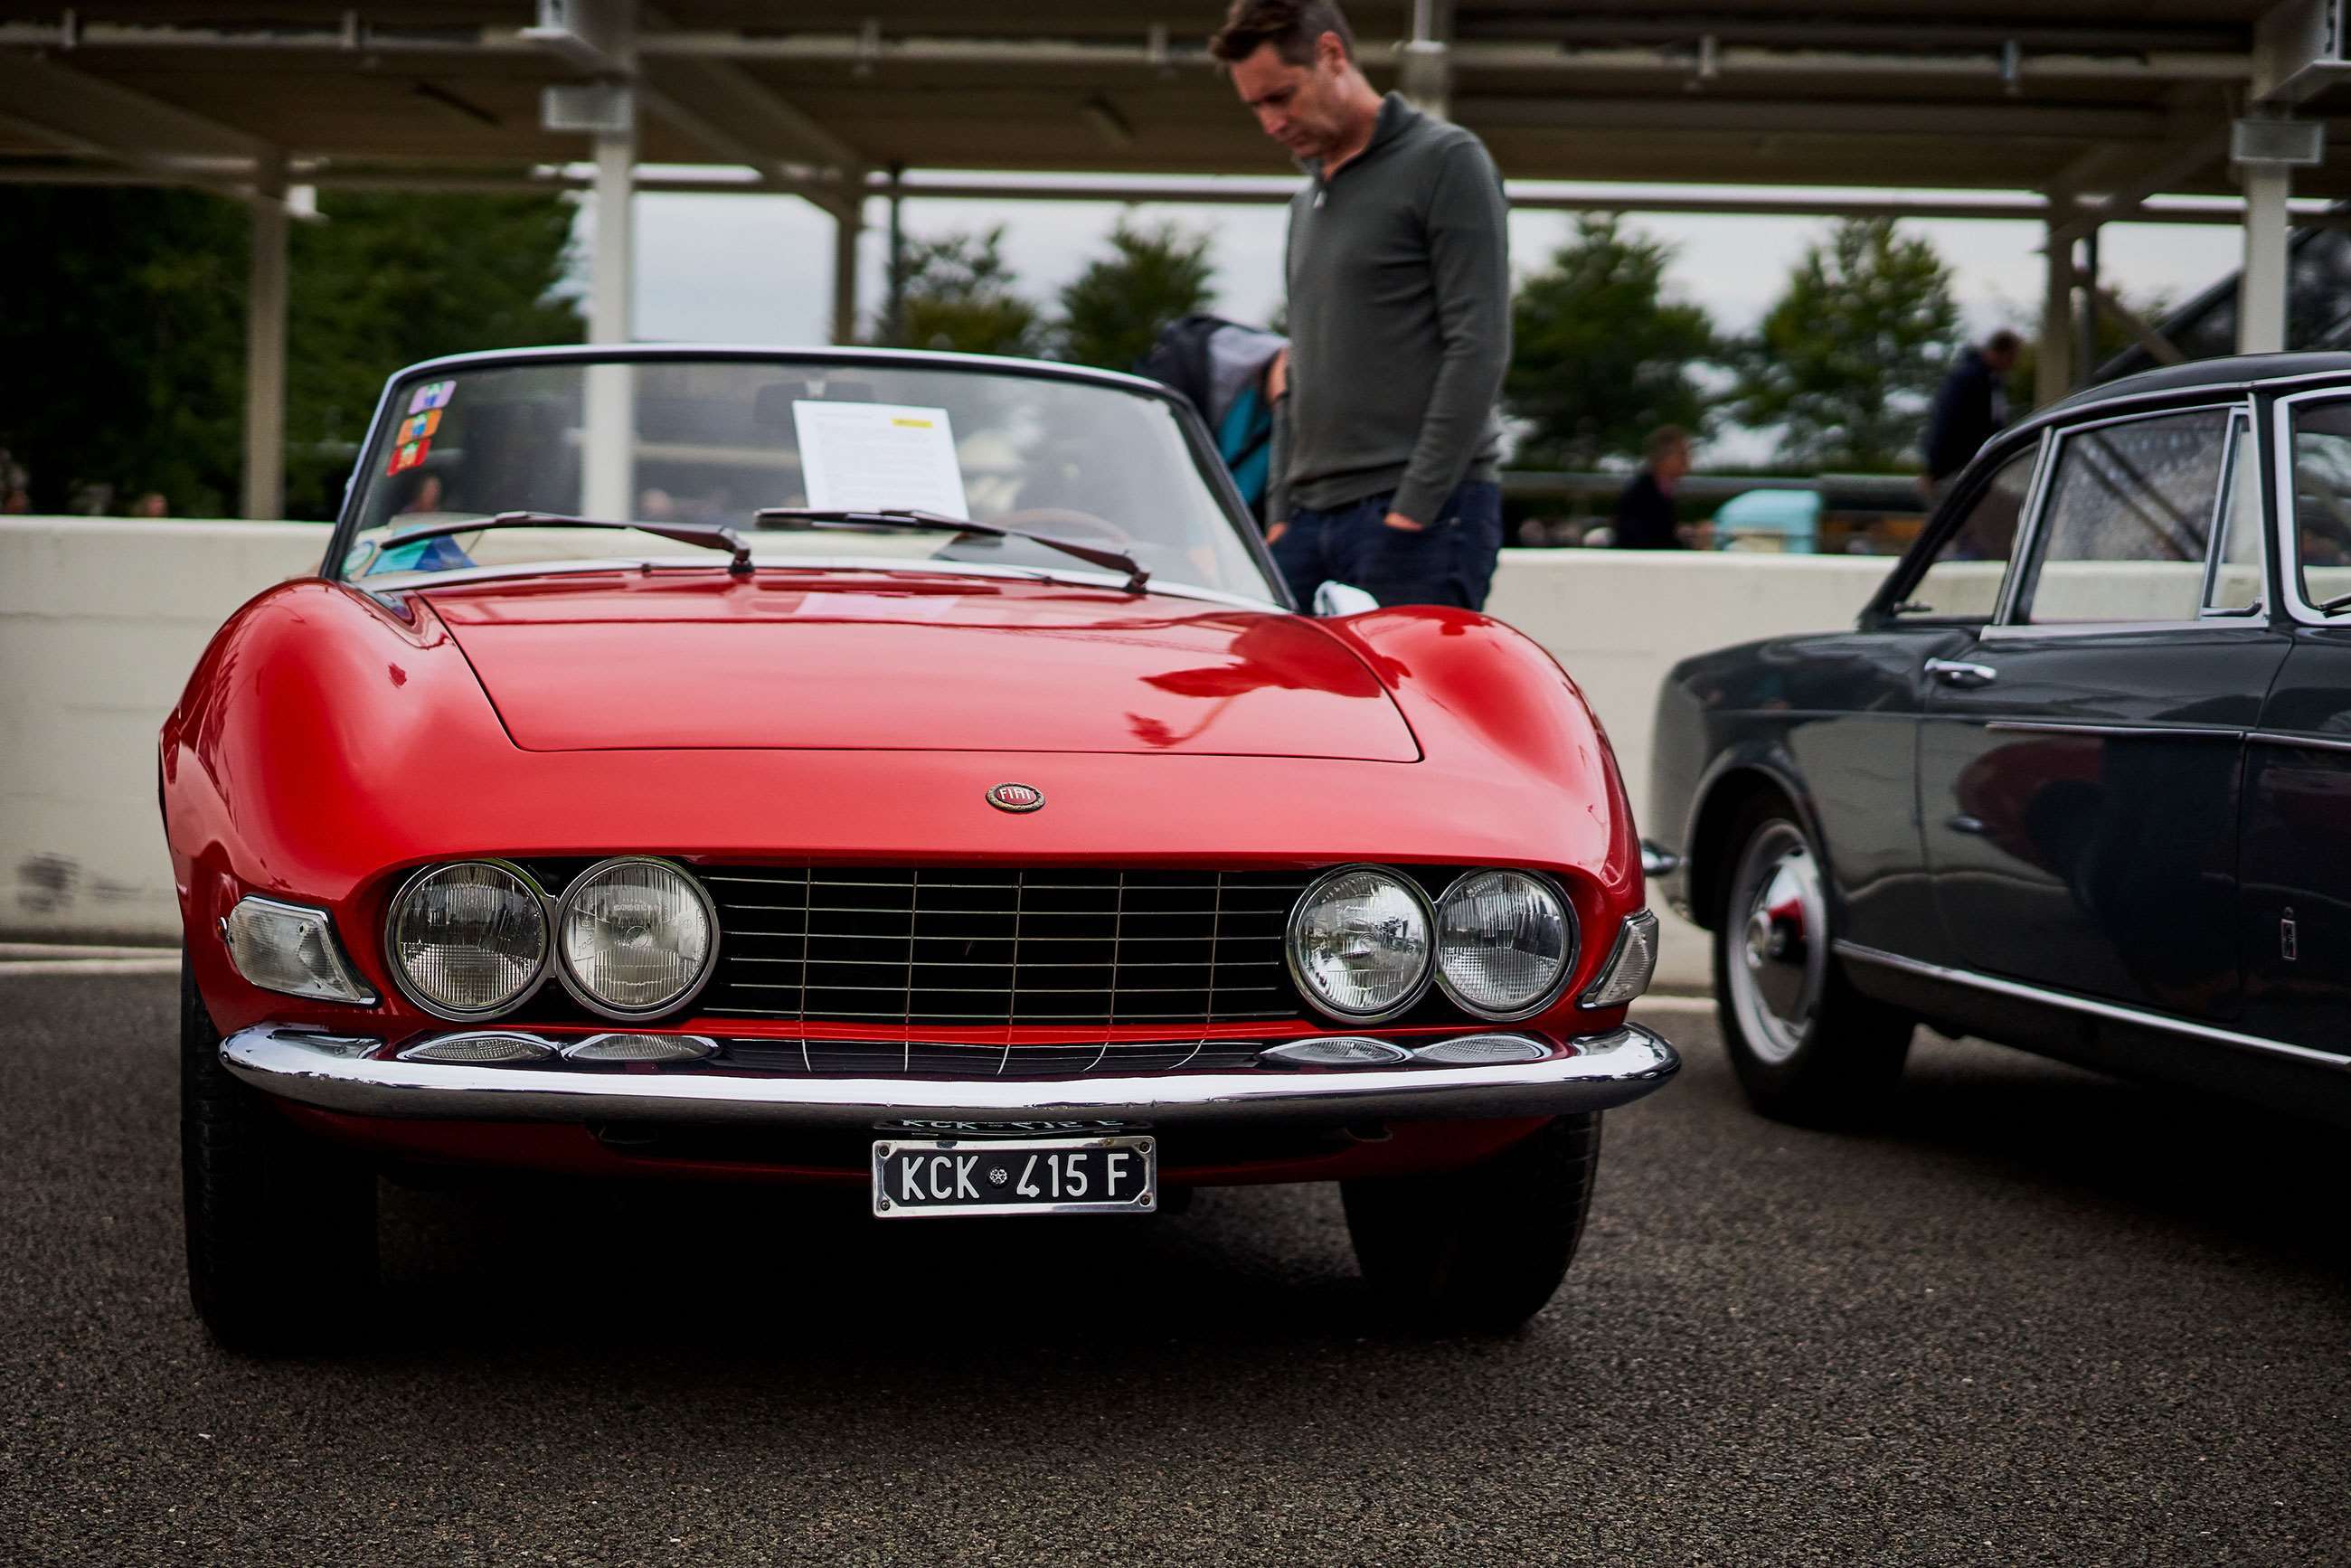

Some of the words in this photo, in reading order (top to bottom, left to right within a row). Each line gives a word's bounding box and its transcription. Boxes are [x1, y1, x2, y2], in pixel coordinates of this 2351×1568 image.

[999, 788, 1031, 799] FIAT
[902, 1157, 979, 1200] KCK
[1016, 1154, 1088, 1197] 415
[1108, 1153, 1129, 1196] F
